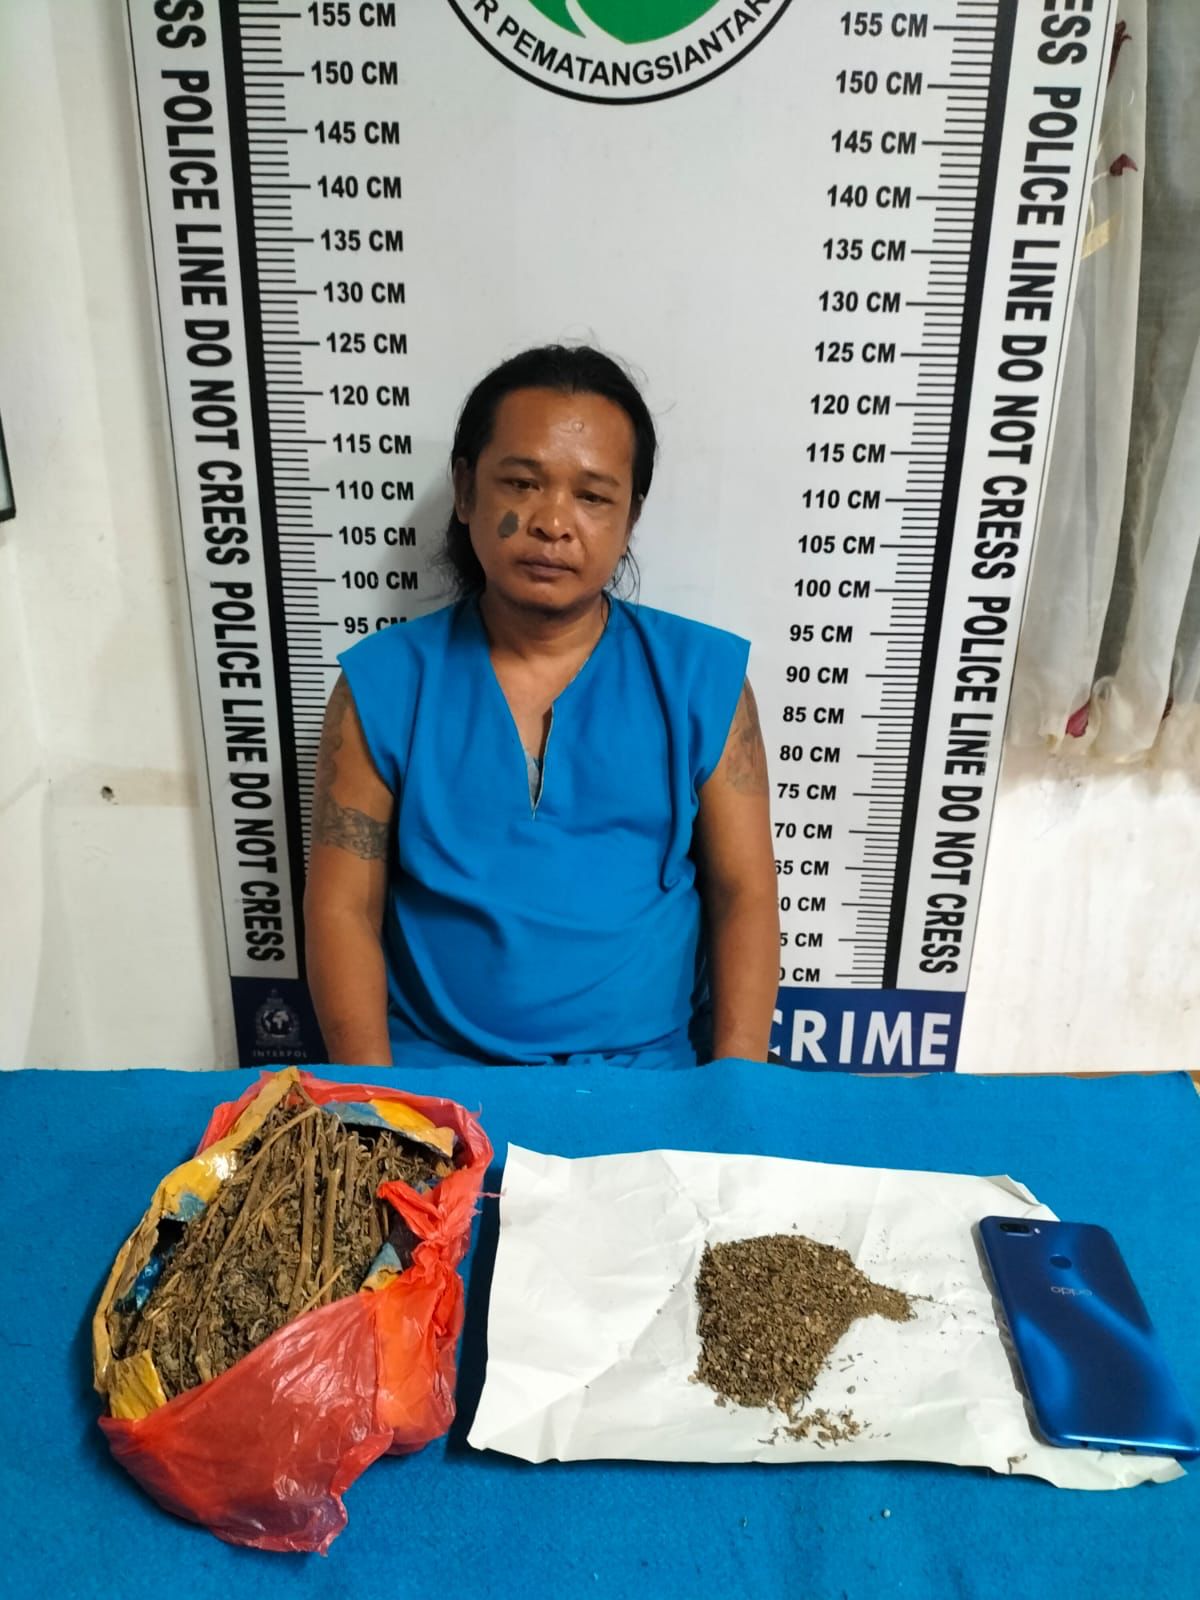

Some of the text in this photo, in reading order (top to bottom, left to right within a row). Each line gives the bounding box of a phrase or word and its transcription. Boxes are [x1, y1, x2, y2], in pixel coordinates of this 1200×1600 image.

[308, 2, 396, 27] 155 CM
[474, 0, 499, 24] R
[841, 12, 928, 37] 155 CM
[312, 61, 397, 85] 150 CM
[836, 70, 922, 95] 150 CM
[161, 70, 219, 209] POLICE
[315, 120, 399, 144] 145 CM
[832, 130, 916, 154] 145 CM
[1017, 87, 1081, 225] POLICE
[318, 176, 401, 198] 140 CM
[828, 185, 911, 208] 140 CM
[321, 229, 403, 251] 135 CM
[823, 238, 906, 261] 135 CM
[176, 224, 227, 306] LINE
[324, 281, 405, 303] 130 CM
[1005, 240, 1060, 321] LINE
[819, 291, 900, 312] 130 CM
[185, 320, 232, 367] DO
[327, 332, 407, 354] 125 CM
[815, 342, 895, 363] 125 CM
[998, 335, 1047, 382] DO
[330, 385, 409, 406] 120 CM
[811, 394, 890, 415] 120 CM
[190, 380, 240, 450] NOT
[988, 395, 1039, 464] NOT
[333, 433, 411, 454] 115 CM
[807, 443, 885, 463] 115 CM
[336, 480, 414, 500] 110 CM
[803, 490, 880, 509] 110 CM
[198, 461, 250, 565] CRESS
[339, 526, 416, 547] 105 CM
[972, 476, 1027, 579] CRESS
[799, 535, 875, 554] 105 CM
[342, 571, 418, 590] 100 CM
[795, 579, 870, 598] 100 CM
[210, 582, 261, 688] POLICE
[344, 616, 408, 634] 95 C
[790, 624, 853, 643] 95 CM
[954, 596, 1010, 702] POLICE
[787, 666, 848, 684] 90 CM
[783, 706, 844, 724] 85 CM
[222, 699, 268, 762] LINE
[780, 745, 840, 763] 80 CM
[944, 713, 993, 775] LINE
[230, 773, 272, 809] DO
[777, 783, 836, 800] 75 CM
[939, 786, 982, 822] DO
[775, 823, 832, 839] 70 CM
[235, 819, 278, 874] NOT
[801, 861, 829, 875] CM
[931, 832, 976, 885] NOT
[779, 896, 826, 911] 0 CM
[241, 881, 285, 962] CRESS
[919, 893, 967, 973] CRESS
[779, 932, 823, 947] 5 CM
[792, 968, 820, 982] CM
[253, 1050, 307, 1058] INTERPOL
